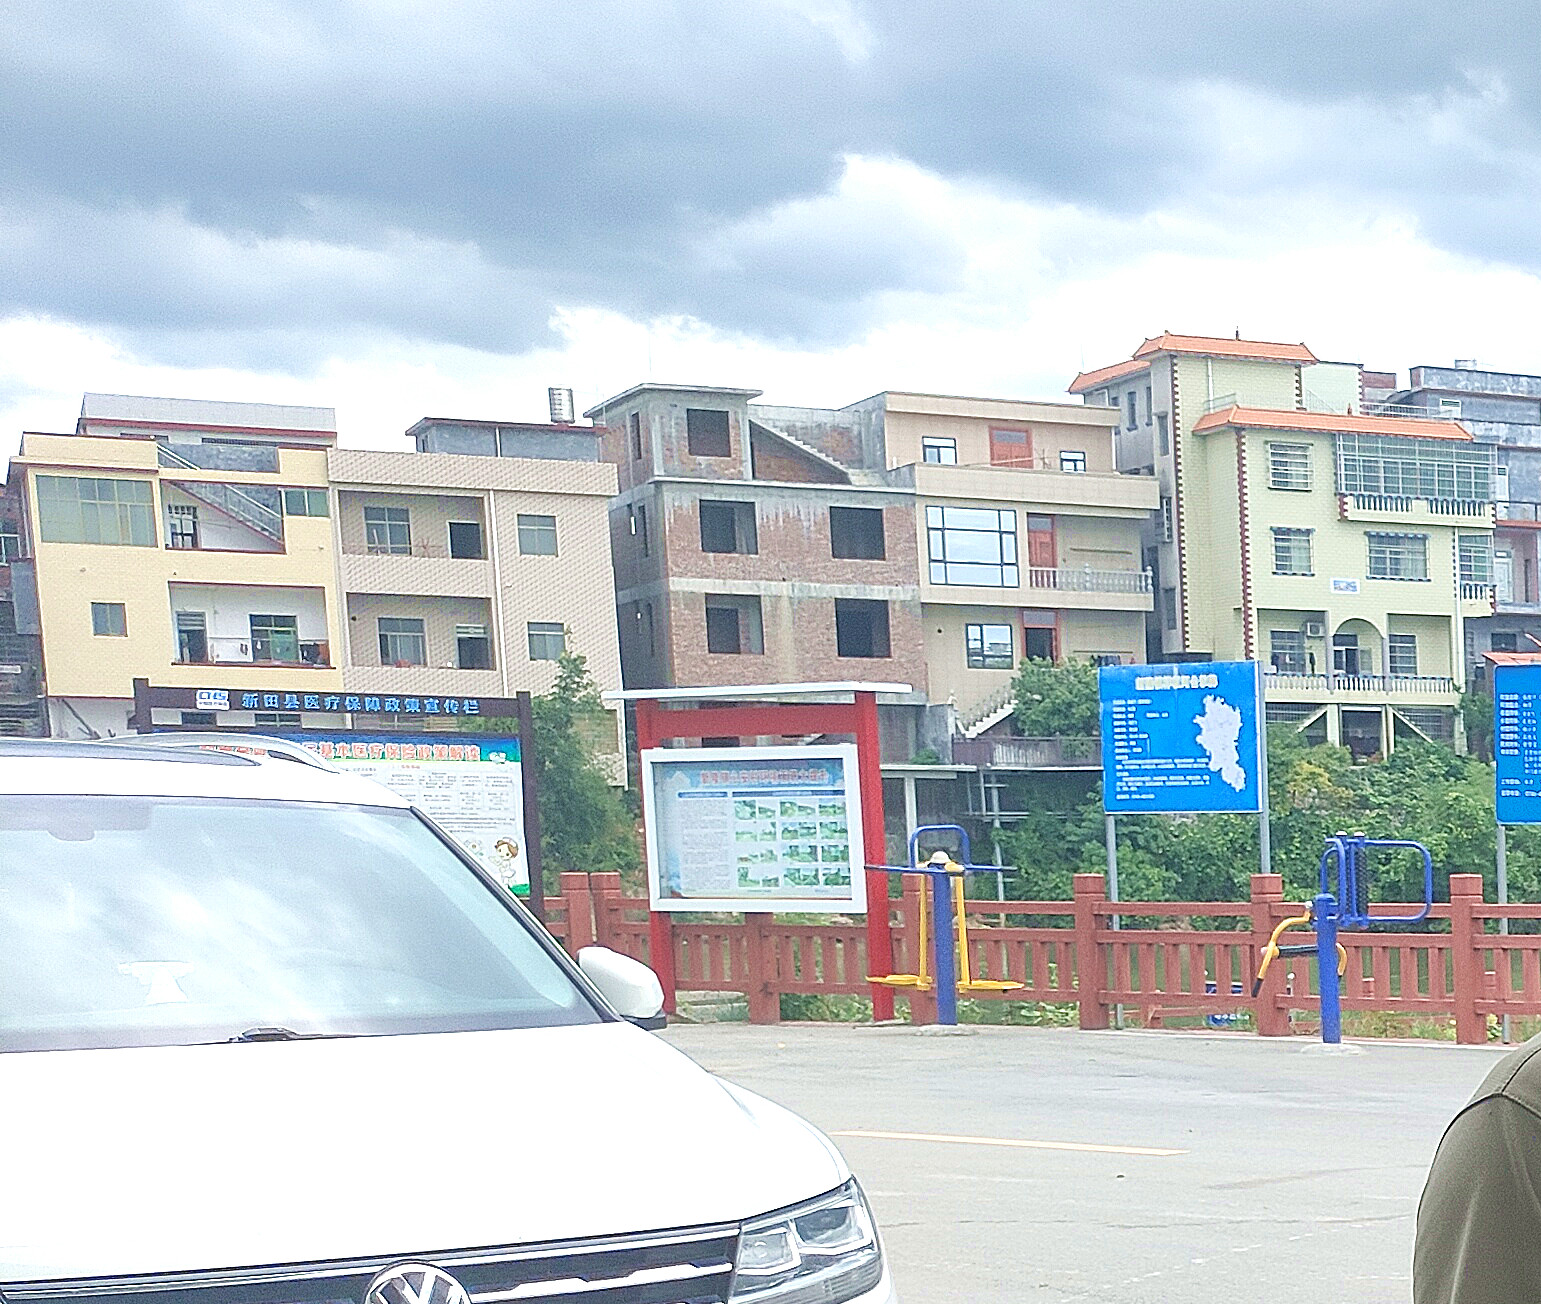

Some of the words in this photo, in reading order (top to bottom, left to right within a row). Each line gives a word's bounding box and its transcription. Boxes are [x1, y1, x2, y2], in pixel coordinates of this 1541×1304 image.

[241, 693, 480, 714] 新田县医疗保障政策宣传栏
